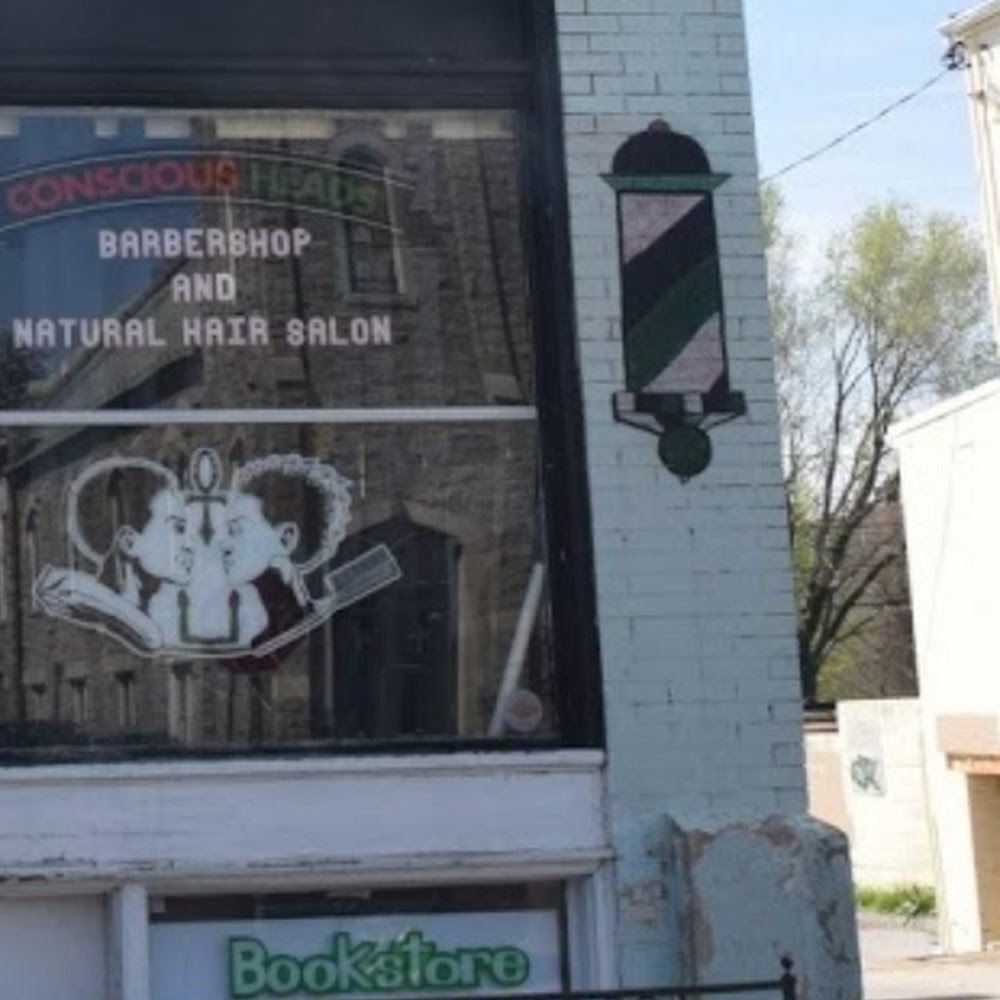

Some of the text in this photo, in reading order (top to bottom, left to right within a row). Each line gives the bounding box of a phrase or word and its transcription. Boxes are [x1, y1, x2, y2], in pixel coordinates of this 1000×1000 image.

[6, 158, 239, 214] CONSCIOUS
[98, 228, 312, 259] BARBERSHOP
[172, 273, 237, 302] AND
[12, 315, 393, 348] NATURAL HAIR SALON
[228, 930, 530, 999] Bookstore
